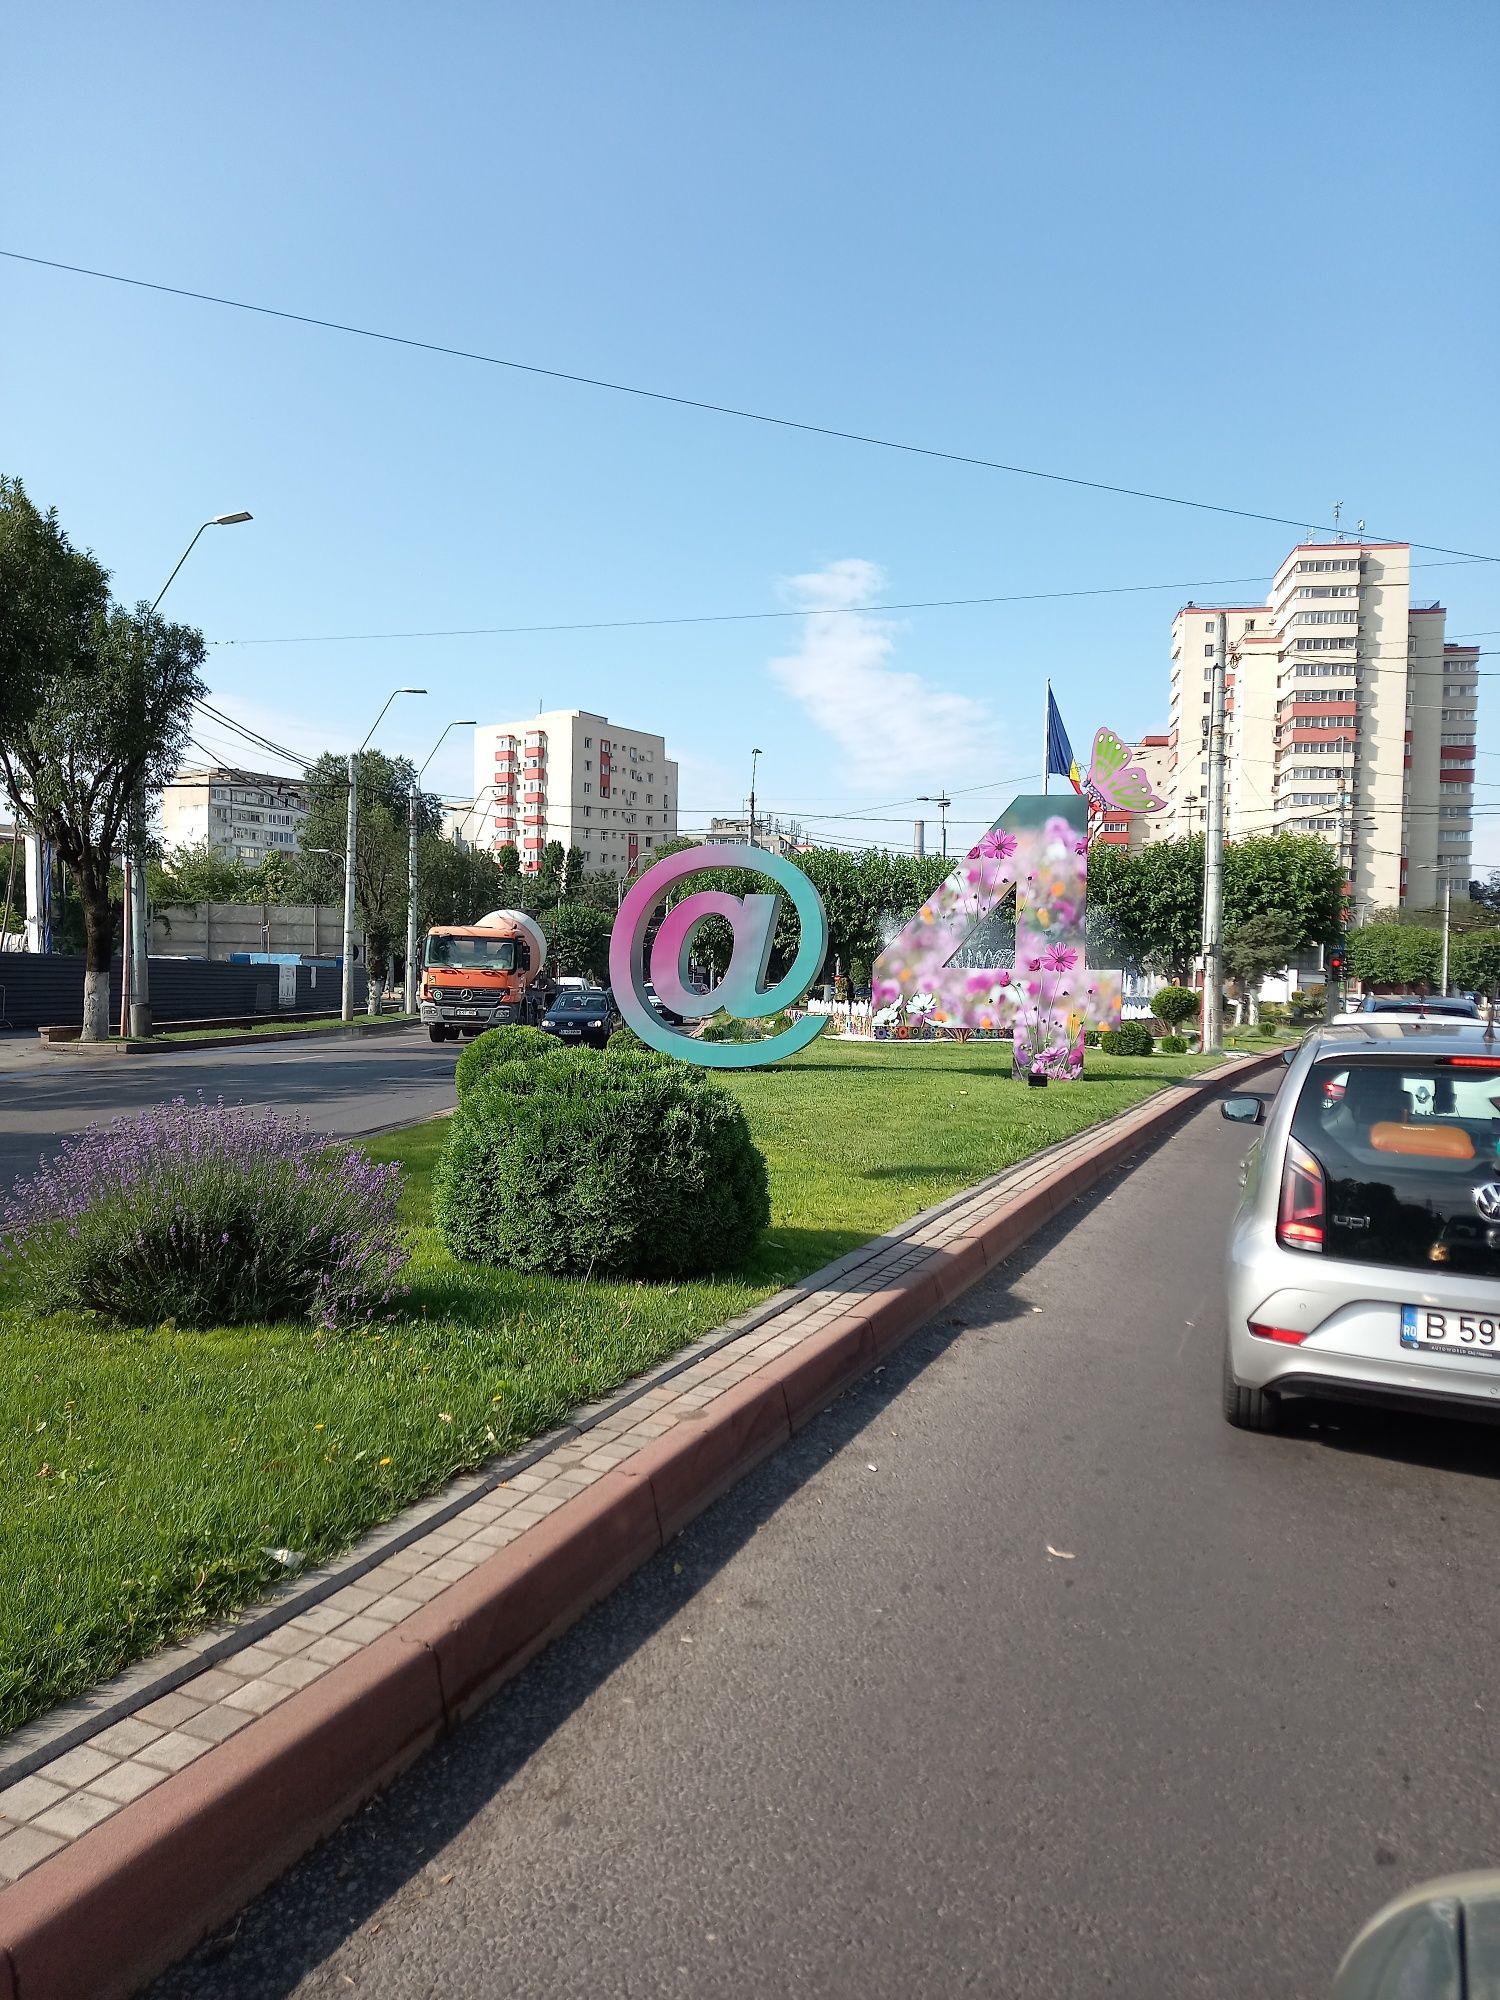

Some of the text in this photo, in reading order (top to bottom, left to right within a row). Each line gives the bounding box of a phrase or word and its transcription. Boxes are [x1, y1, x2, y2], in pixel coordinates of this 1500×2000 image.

[609, 795, 1122, 1081] @ 4
[1334, 1215, 1371, 1230] up!
[1403, 1324, 1417, 1337] RO
[1426, 1312, 1500, 1346] B 59
[1431, 1345, 1467, 1355] AUTOWORLD
